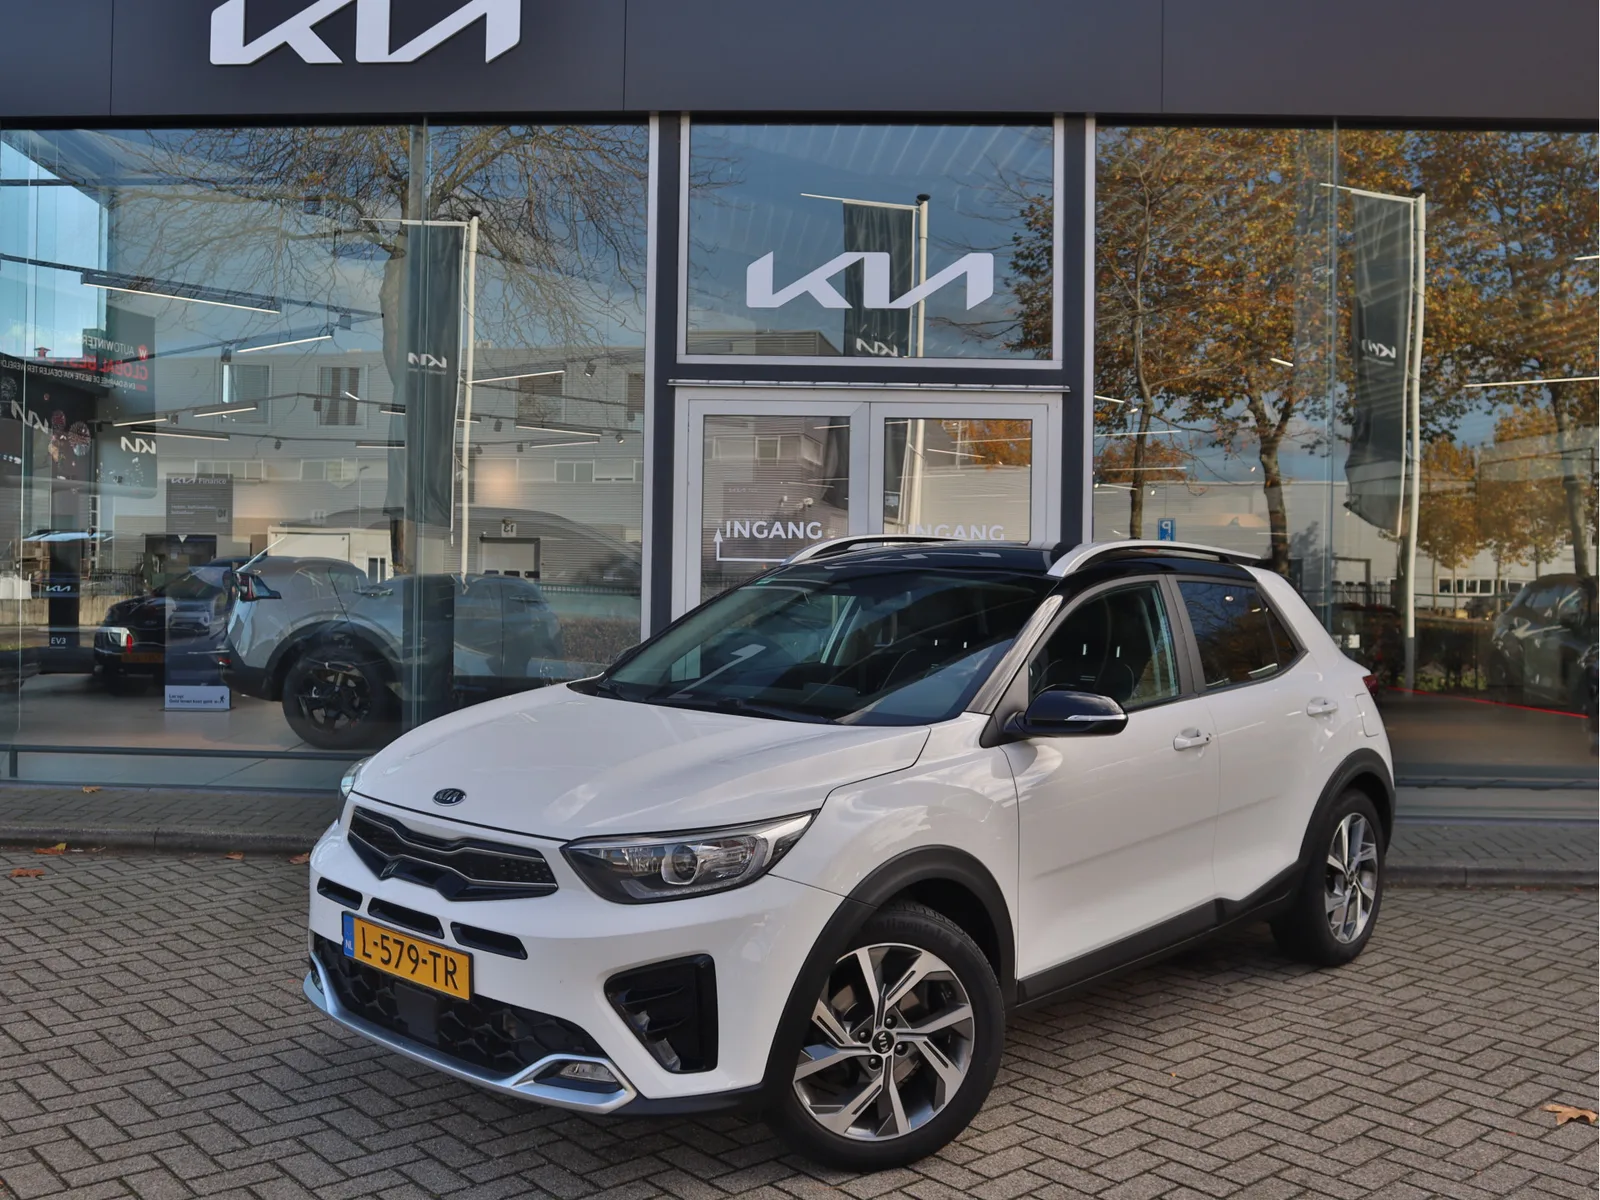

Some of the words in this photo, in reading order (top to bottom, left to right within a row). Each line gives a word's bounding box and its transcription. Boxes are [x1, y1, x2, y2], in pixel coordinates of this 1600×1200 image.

[209, 0, 522, 65] KIA
[746, 251, 994, 311] KIA
[725, 520, 823, 540] INGANG
[908, 523, 1005, 541] INGANG
[50, 637, 66, 645] EV3
[345, 939, 353, 950] NL
[361, 926, 458, 991] L-579-TR
[878, 1032, 889, 1052] KIA
